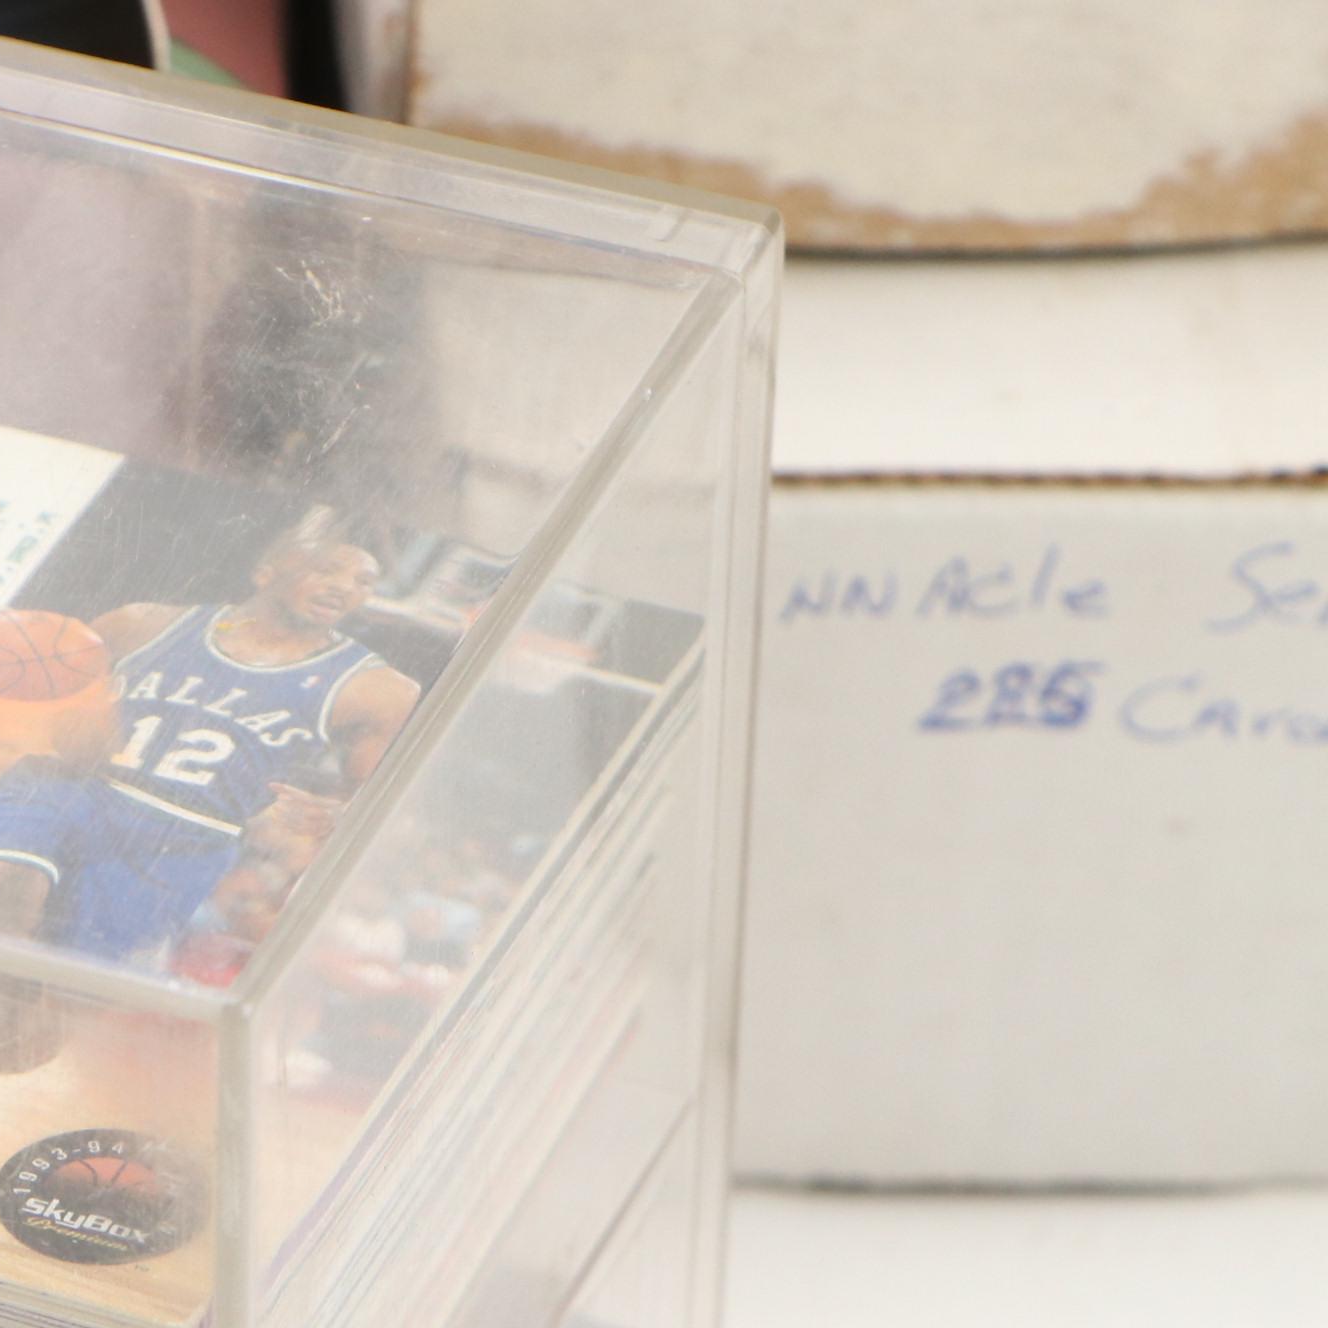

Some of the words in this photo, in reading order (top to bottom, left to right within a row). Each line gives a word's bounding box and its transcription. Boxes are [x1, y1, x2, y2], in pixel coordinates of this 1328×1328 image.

[110, 714, 236, 786] 12
[13, 1139, 126, 1196] 1993-94
[22, 1197, 152, 1246] SkyBox
